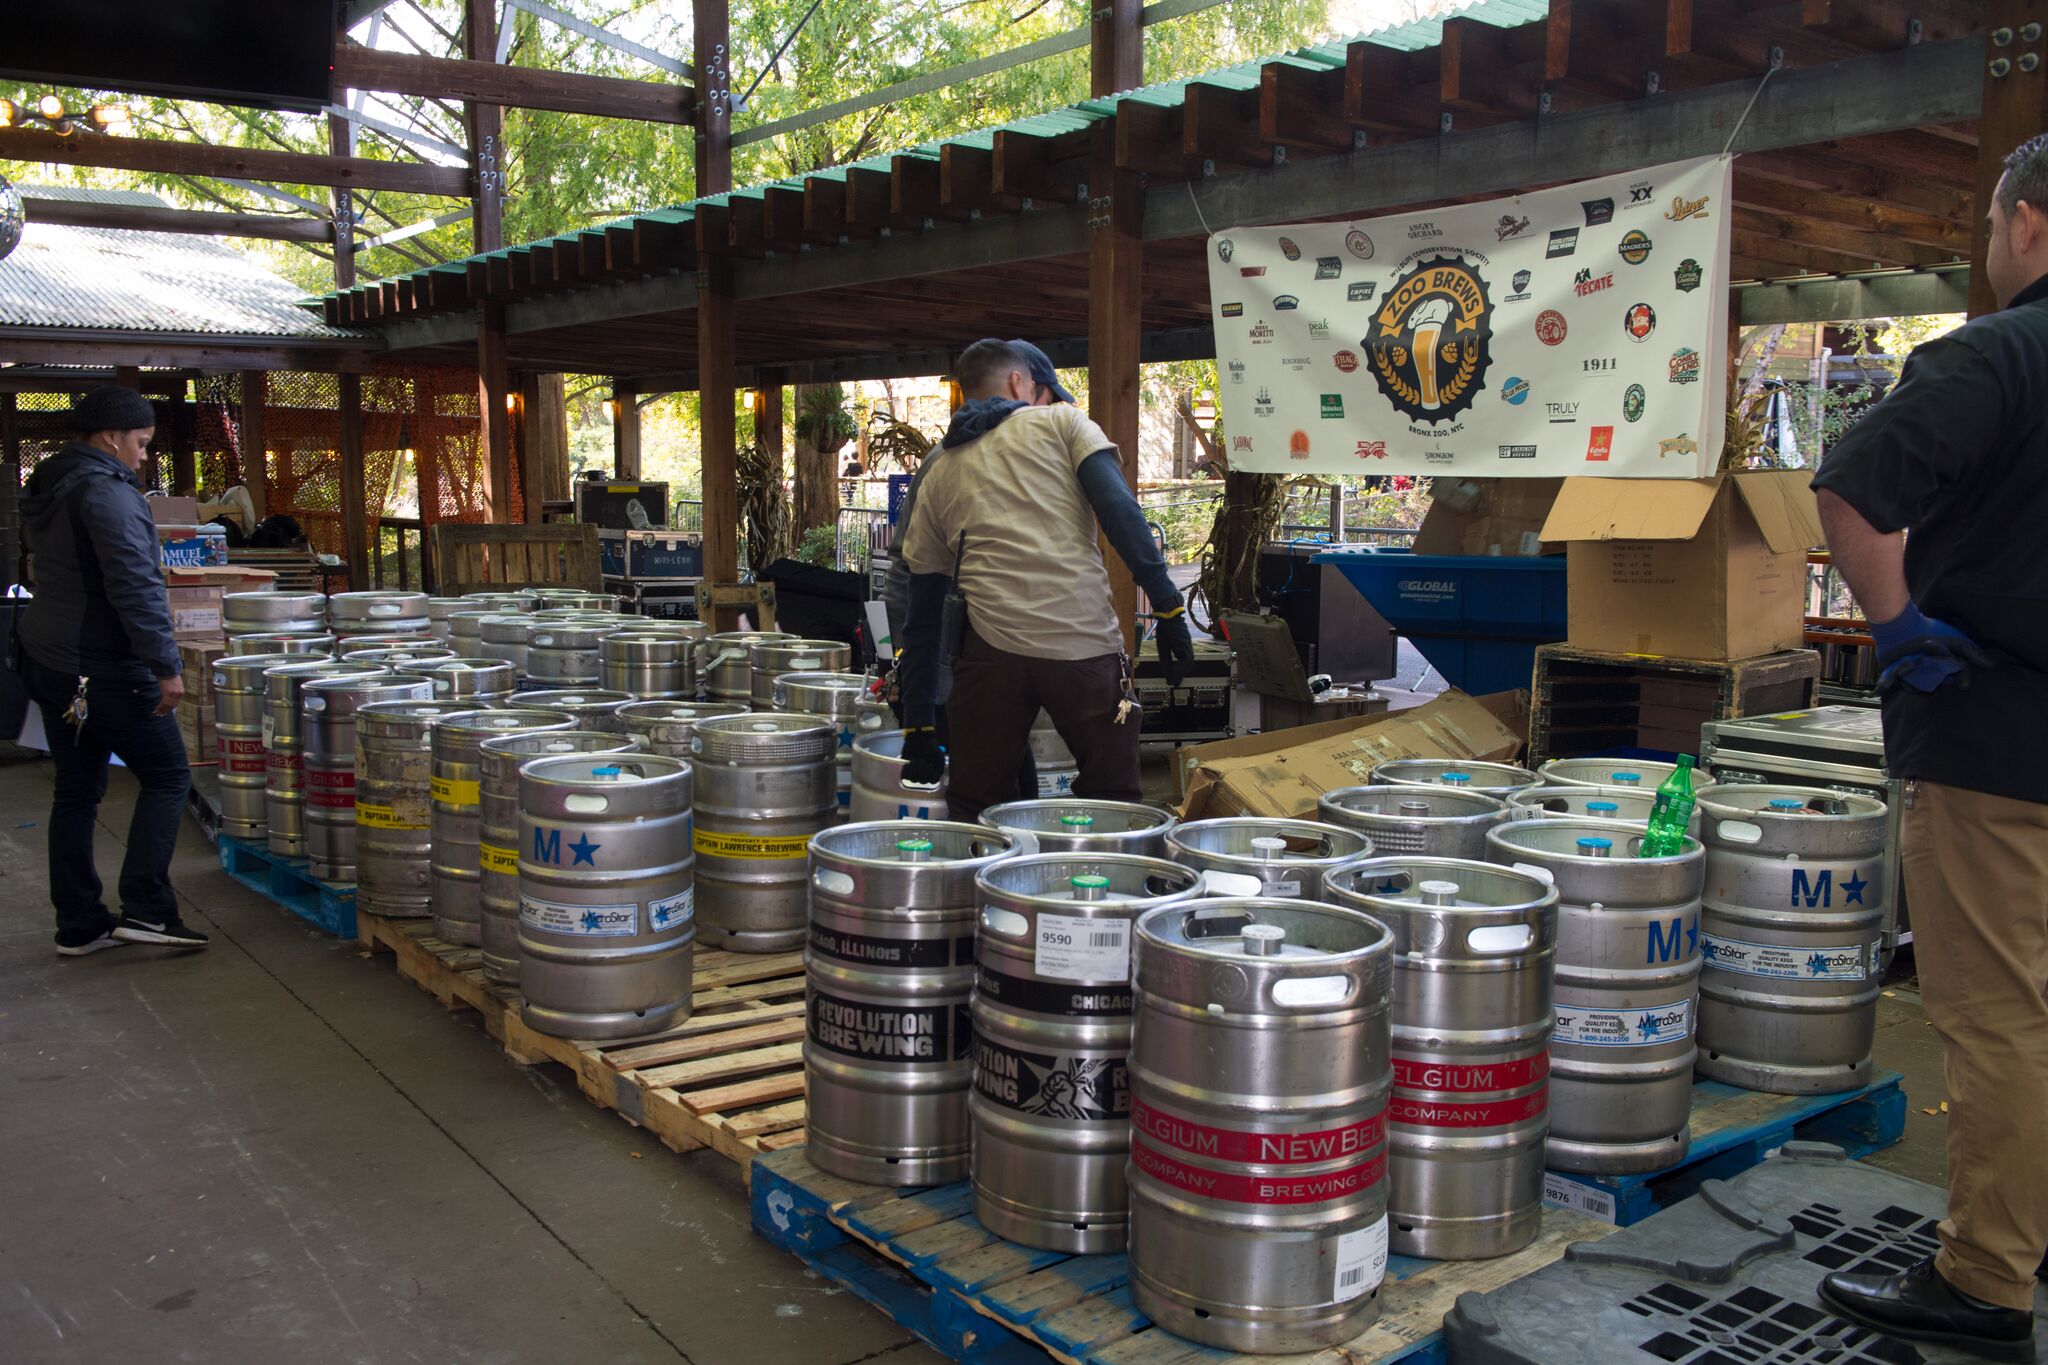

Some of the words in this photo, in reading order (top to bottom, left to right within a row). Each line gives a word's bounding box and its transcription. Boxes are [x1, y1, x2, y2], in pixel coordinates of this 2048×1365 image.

[1629, 186, 1654, 203] XX
[1664, 196, 1710, 222] Shiner
[1407, 229, 1443, 240] ORCHARD
[1408, 222, 1435, 232] ANGRY
[1390, 254, 1414, 278] WILDLIFE
[1412, 246, 1463, 258] CONSERVATION
[1464, 248, 1490, 267] SOCIETY
[1350, 288, 1373, 296] EMPIRE
[1574, 274, 1614, 298] TECATE
[1387, 277, 1426, 319] ZOO
[1432, 271, 1480, 314] BREWS
[1249, 329, 1274, 338] MORETTI
[1308, 318, 1330, 336] peak
[1582, 358, 1618, 372] 1911
[1669, 352, 1699, 368] CONEY
[1670, 361, 1700, 378] ISLAND
[1546, 401, 1580, 415] TRULY
[1408, 425, 1431, 437] BRONX
[1433, 429, 1450, 438] ZOO,
[1450, 422, 1465, 434] NYC
[163, 547, 205, 560] AMUEL
[167, 558, 201, 568] DAMS
[1408, 580, 1456, 593] GLOBAL
[234, 741, 263, 754] NEW
[234, 761, 263, 769] BREW
[308, 773, 345, 786] LGIUM
[364, 810, 391, 822] CAPTAIN
[533, 826, 561, 866] M
[696, 837, 719, 850] CAPTAIN
[720, 841, 762, 853] LAWRENCE
[765, 843, 803, 853] BREWING
[493, 854, 515, 867] CAPTA
[1791, 869, 1832, 908] M
[580, 910, 632, 924] MicroStar
[1042, 932, 1072, 946] 9590
[1647, 920, 1681, 964] M
[840, 940, 901, 962] ILLINOIS
[1700, 936, 1748, 960] MicroStar
[1757, 955, 1780, 963] QUALITY
[1807, 953, 1858, 967] MicroStar
[1071, 993, 1130, 1011] CHICAG
[818, 1000, 934, 1035] REVOLUTION
[1637, 1011, 1686, 1029] MicroStar
[818, 1024, 934, 1057] BREWING
[1579, 1034, 1630, 1043] 1-800-245-2200
[1393, 1058, 1494, 1090] ELGIUM
[1390, 1104, 1491, 1122] COMPANY
[1133, 1108, 1219, 1155] ELGIUM
[1260, 1134, 1337, 1162] NEW
[1136, 1151, 1217, 1190] COMPANY
[1260, 1175, 1358, 1198] BREWING
[1546, 1187, 1570, 1204] 9876
